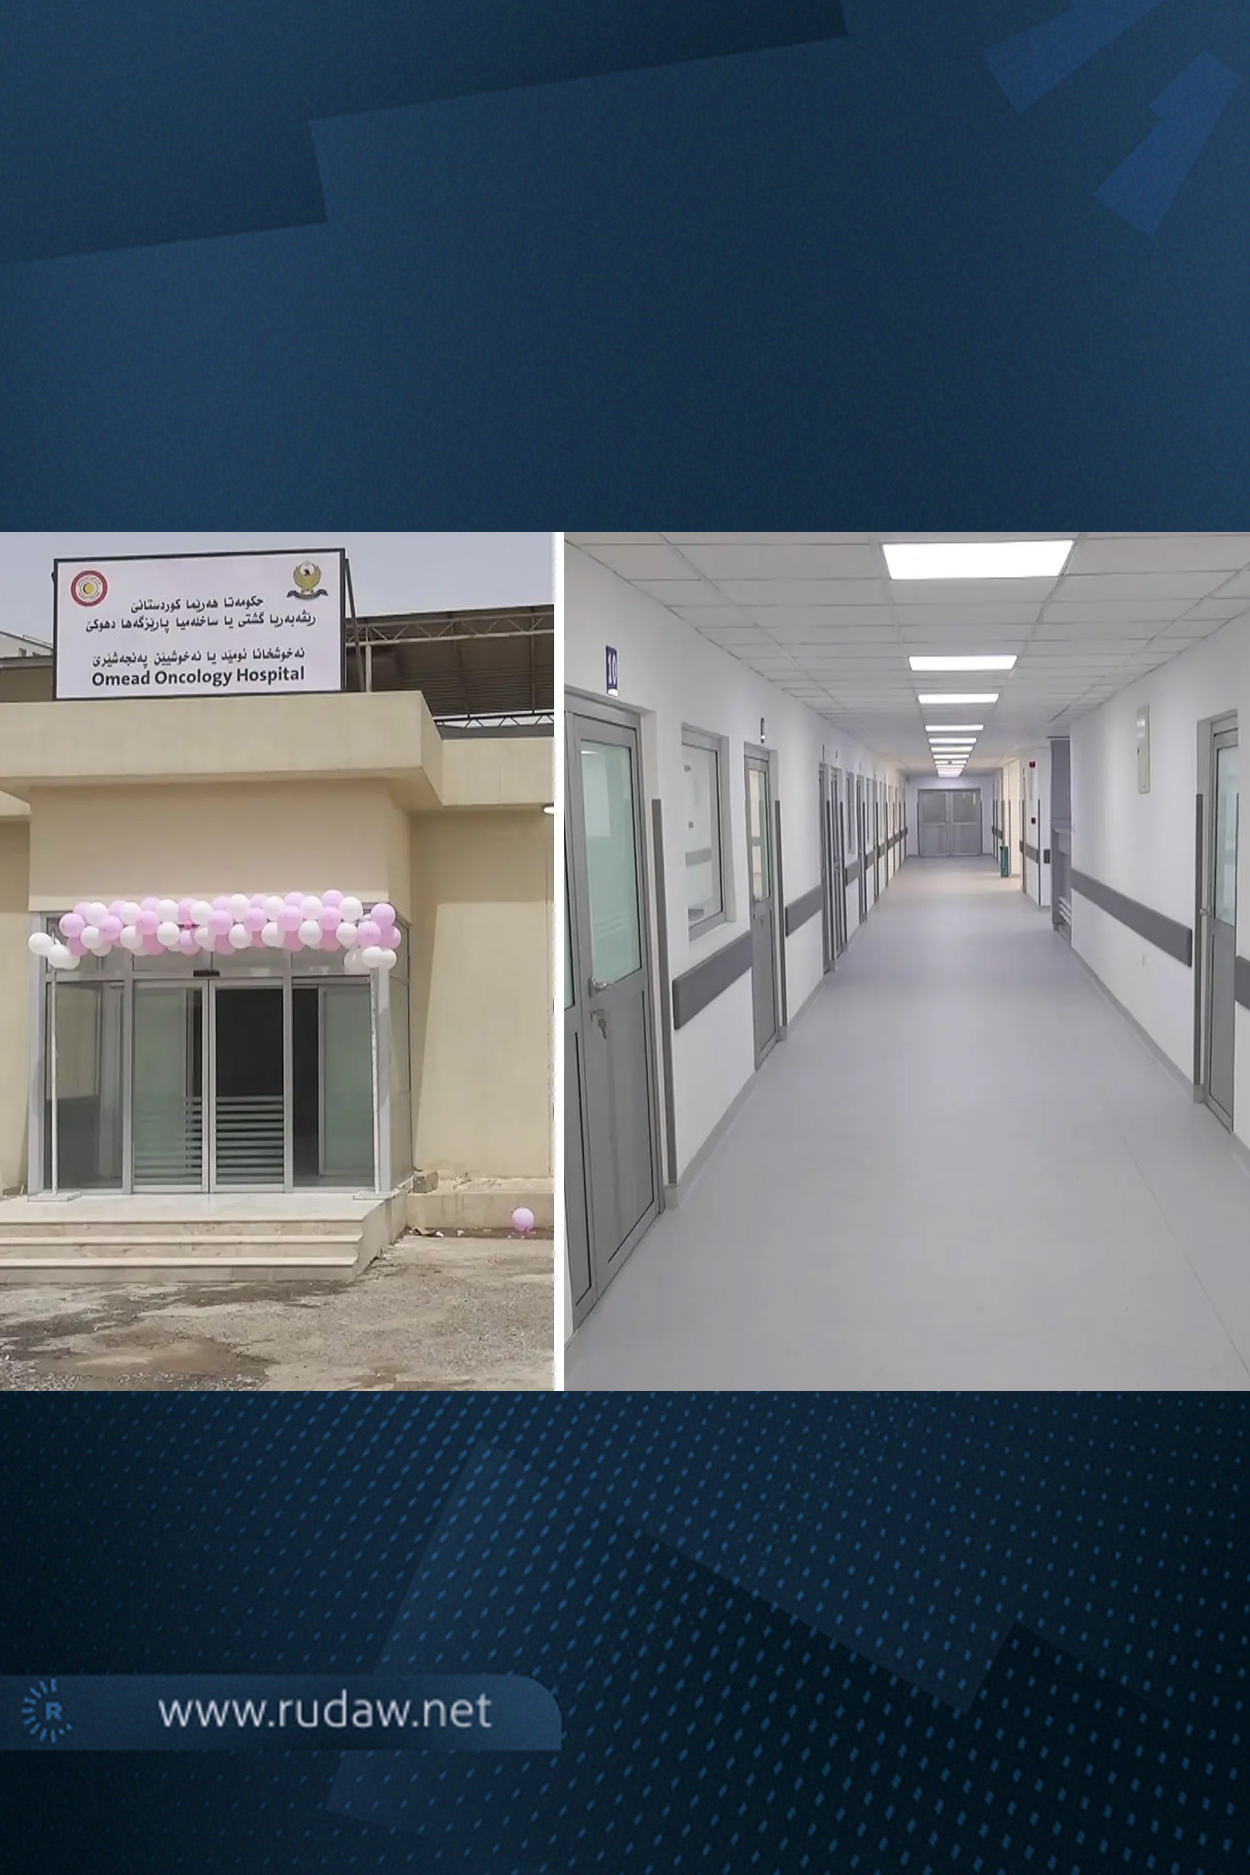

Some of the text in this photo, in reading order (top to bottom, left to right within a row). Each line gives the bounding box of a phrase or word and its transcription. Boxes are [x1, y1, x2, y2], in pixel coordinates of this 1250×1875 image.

[92, 666, 305, 687] Omead Oncology Hospital
